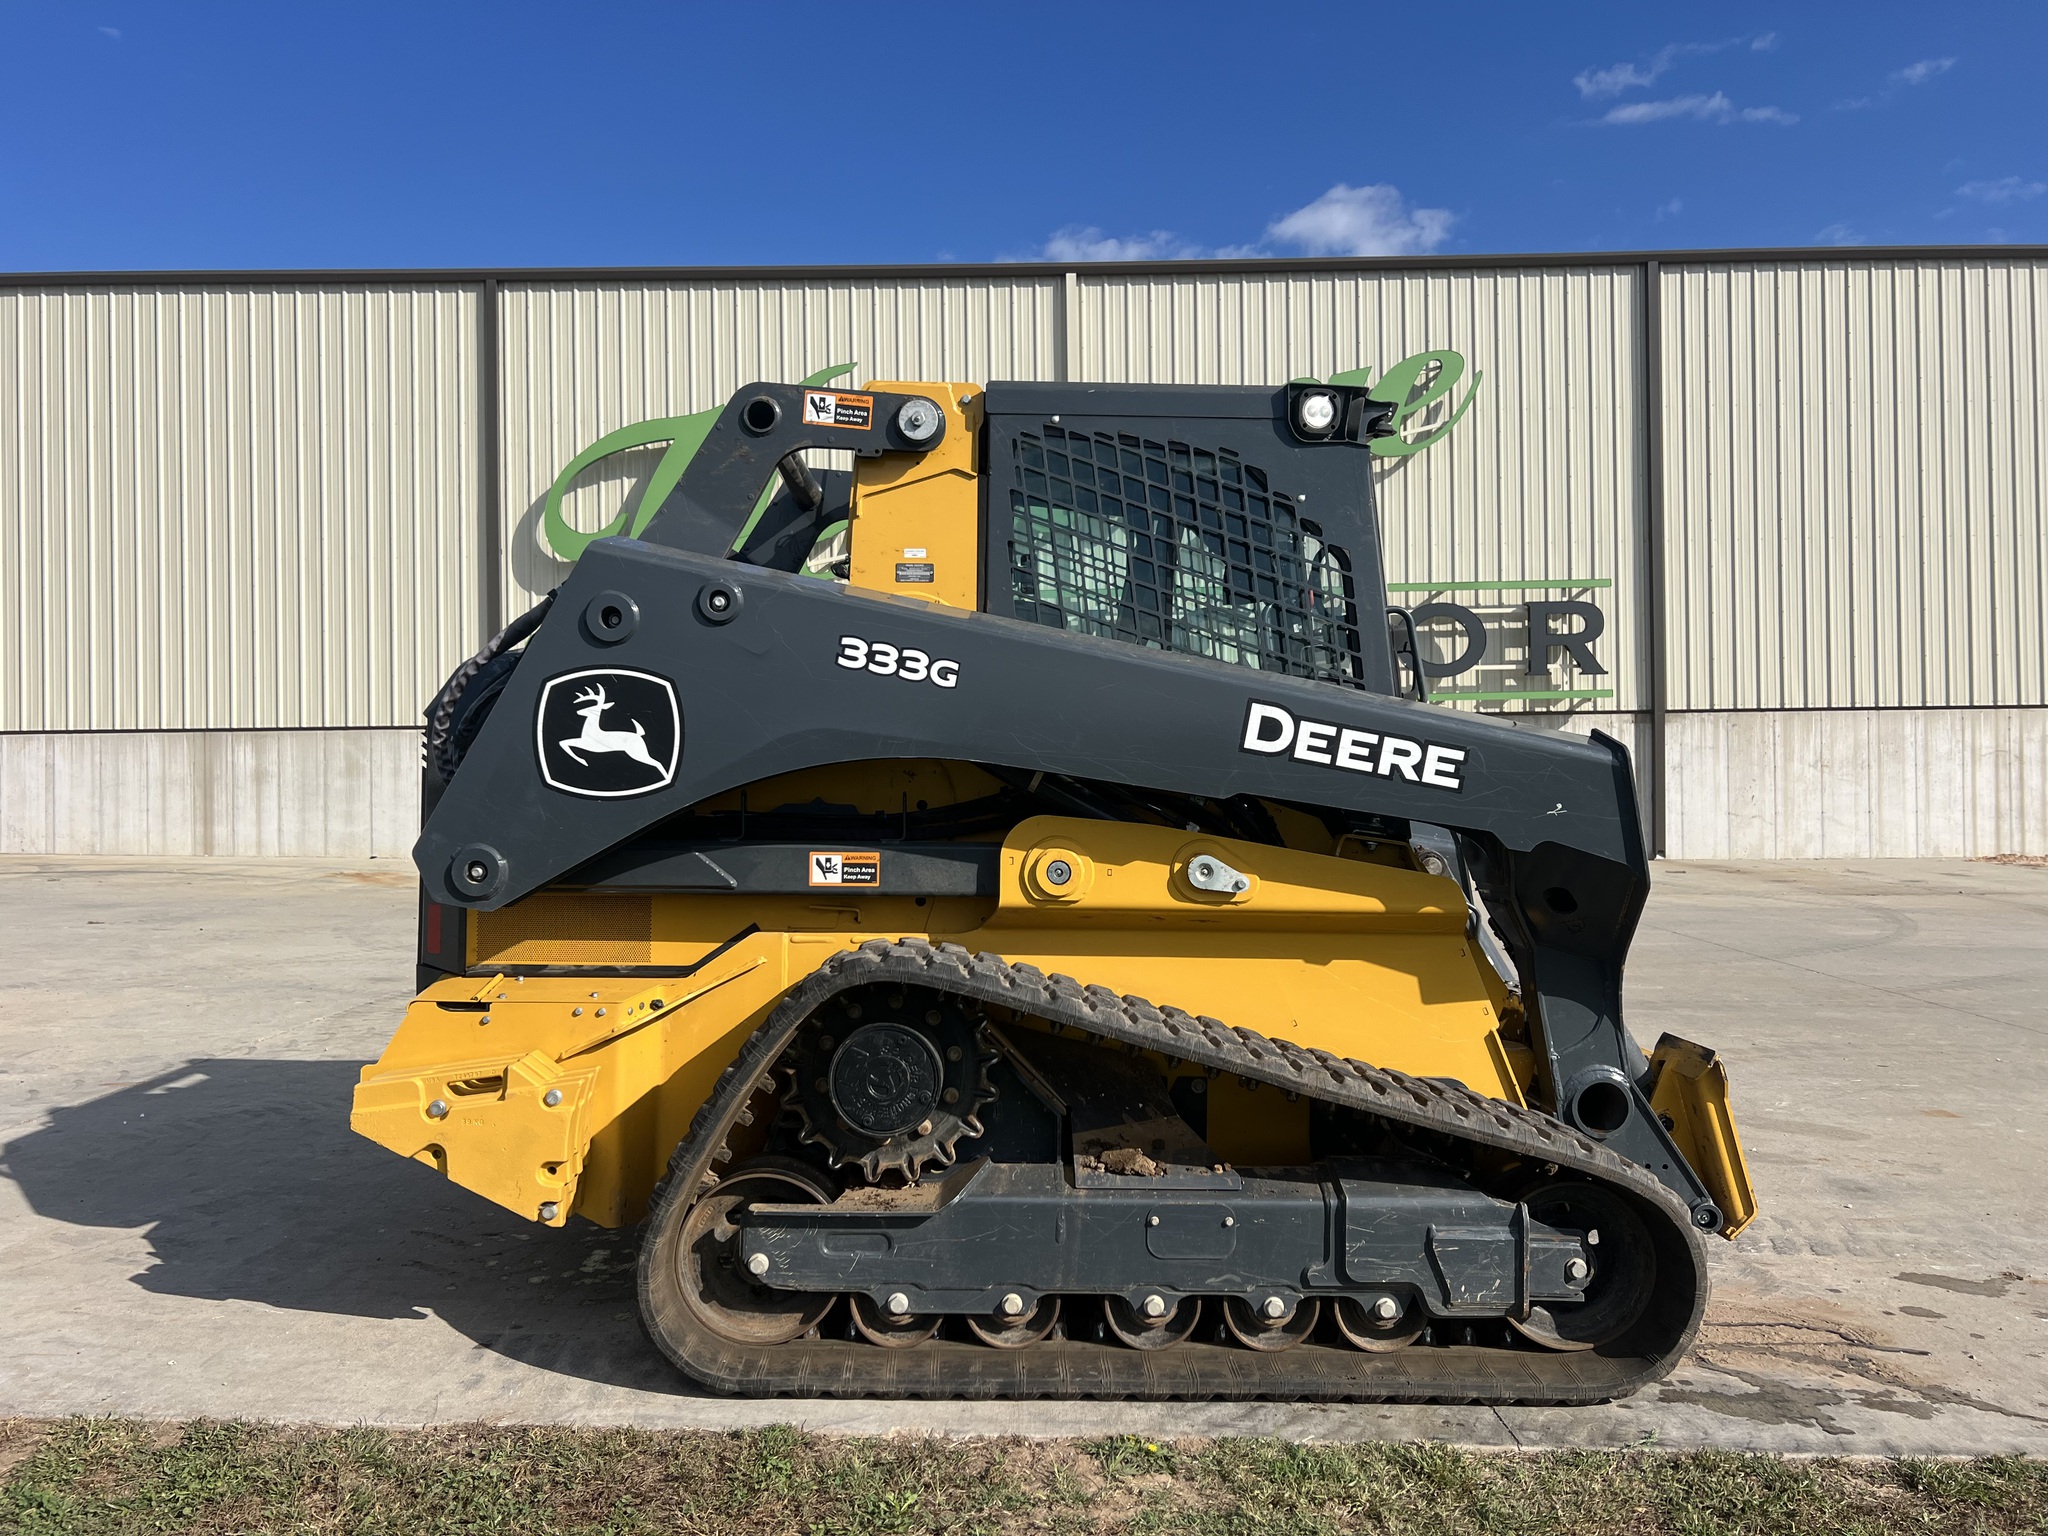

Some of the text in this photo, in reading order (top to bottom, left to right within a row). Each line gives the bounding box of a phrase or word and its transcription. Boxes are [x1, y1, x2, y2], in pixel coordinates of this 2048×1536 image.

[836, 407, 868, 417] Pinch Area
[836, 636, 960, 688] 333G
[1242, 701, 1466, 790] DEERE
